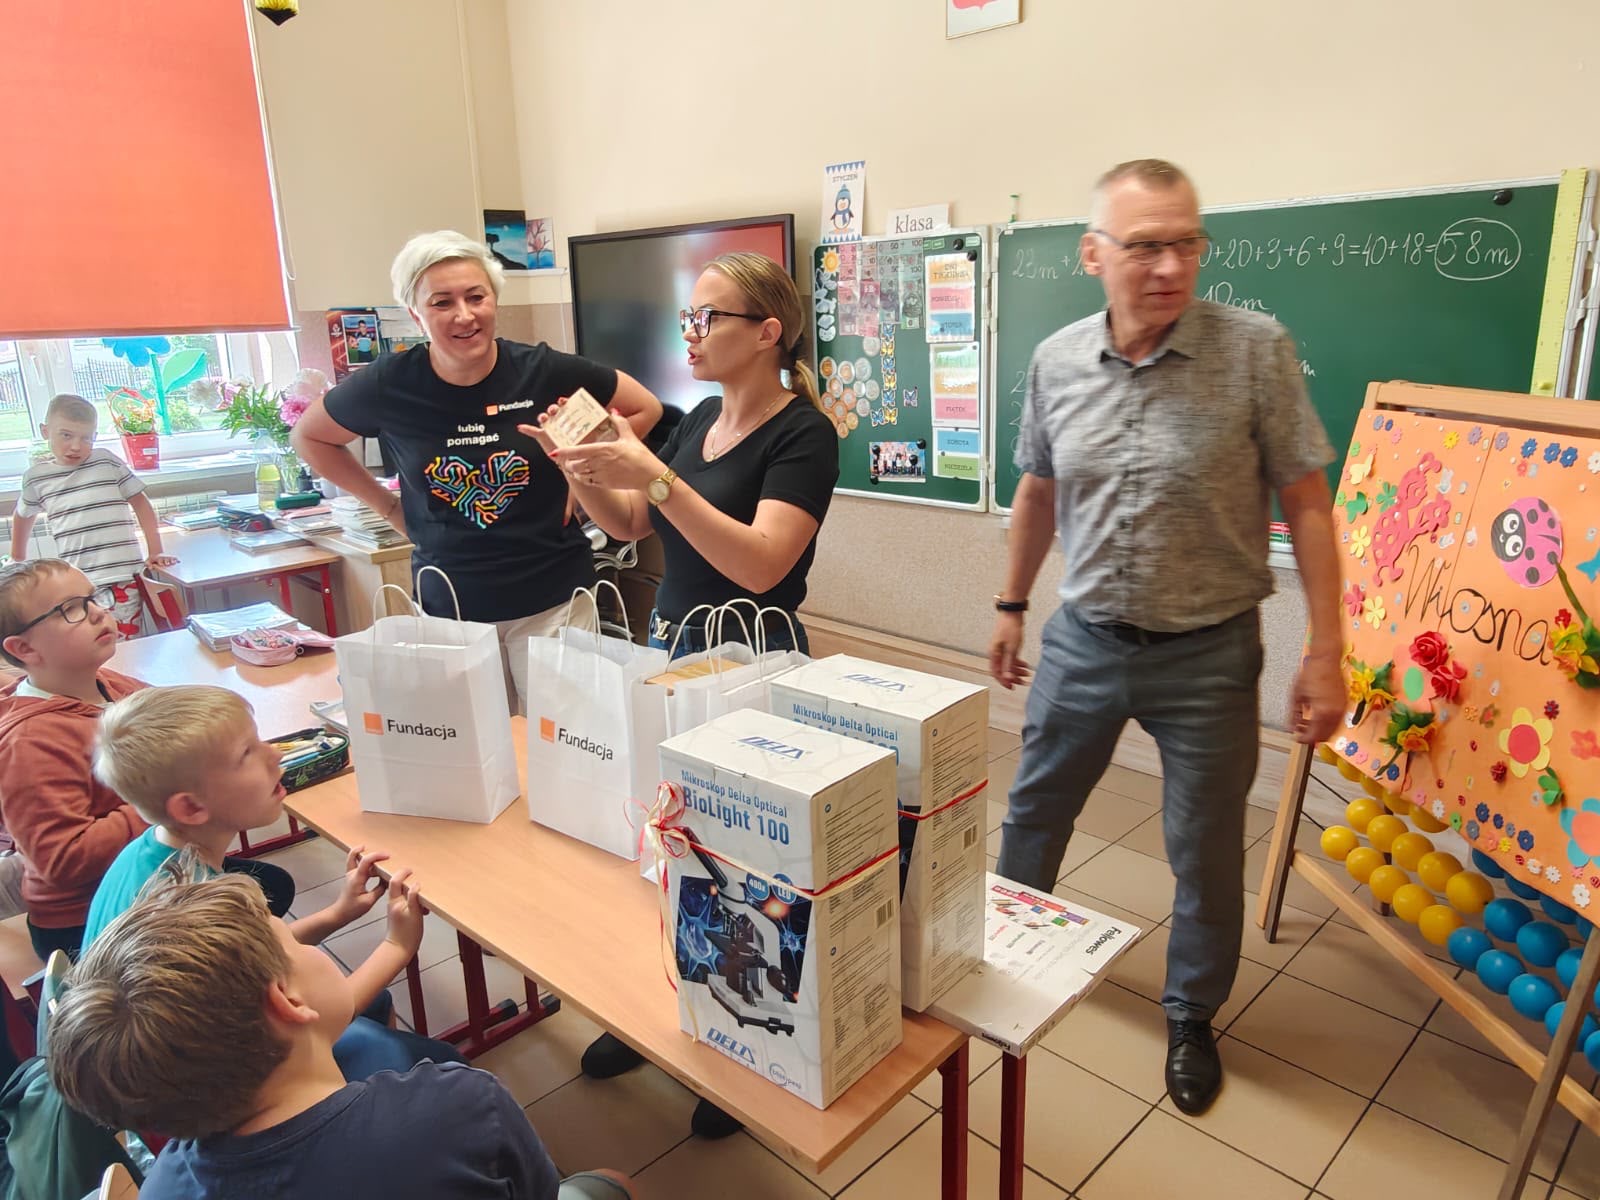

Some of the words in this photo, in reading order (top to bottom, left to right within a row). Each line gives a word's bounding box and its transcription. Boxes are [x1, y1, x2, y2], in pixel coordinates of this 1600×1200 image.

[895, 214, 934, 234] klasa
[499, 399, 535, 412] Fundacja
[447, 432, 500, 447] pomagać
[1405, 544, 1551, 666] Wiosna
[387, 718, 458, 740] Fundacja
[792, 703, 837, 728] Mikroskop
[839, 714, 864, 732] Delta
[865, 722, 899, 742] Optical
[557, 727, 614, 761] Fundacja
[681, 769, 726, 798] Mikroskop
[728, 786, 751, 805] Delta
[753, 796, 788, 818] Optical
[682, 786, 751, 831] BioLight
[757, 815, 790, 846] 100
[1085, 926, 1123, 956] Fellowes
